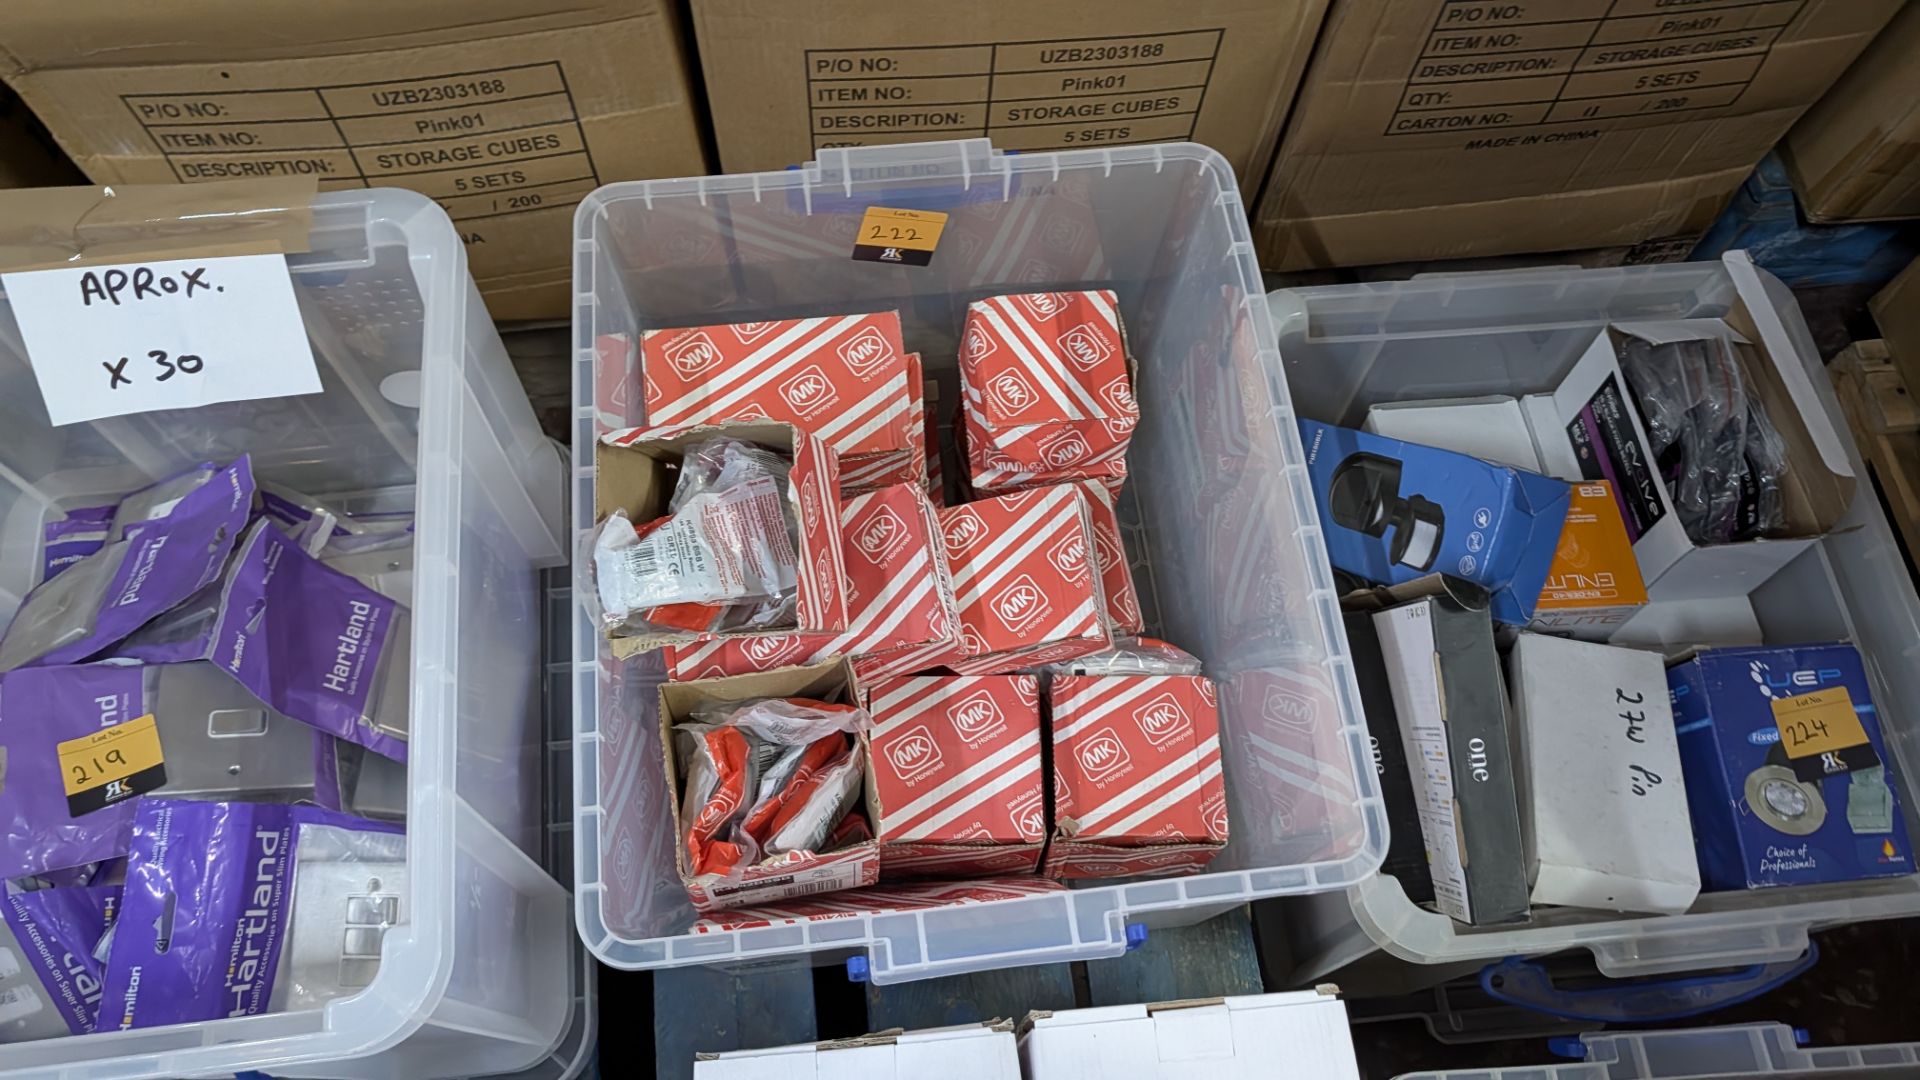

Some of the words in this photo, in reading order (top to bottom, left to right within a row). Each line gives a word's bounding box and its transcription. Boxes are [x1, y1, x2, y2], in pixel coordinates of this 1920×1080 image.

[1446, 8, 1483, 23] P/O
[1485, 5, 1526, 20] NO:
[1658, 16, 1724, 34] Pink01
[1040, 43, 1164, 64] UZB2303188
[1432, 36, 1481, 51] ITEM
[1484, 34, 1523, 48] NO:
[1594, 46, 1689, 65] STORAGE
[1689, 36, 1759, 53] CUBES
[816, 58, 853, 73] P/O
[860, 57, 898, 72] NO:
[1419, 58, 1557, 78] DESCRIPTION:
[1062, 74, 1126, 91] Pink01
[1635, 75, 1648, 89] 5
[1650, 70, 1701, 87] SETS
[372, 79, 506, 107] UZB2303188
[818, 88, 867, 102] ITEM
[874, 87, 912, 100] NO:
[1408, 91, 1453, 106] QTY:
[138, 103, 181, 119] P/O
[184, 102, 229, 117] NO:
[820, 112, 965, 129] DESCRIPTION:
[1008, 103, 1105, 121] STORAGE
[1111, 96, 1180, 114] CUBES
[415, 113, 485, 134] Pink01
[1397, 115, 1475, 131] CARTON
[1478, 112, 1514, 125] NO:
[160, 132, 217, 148] ITEM
[218, 131, 263, 146] NO:
[1063, 131, 1075, 143] 5
[1080, 127, 1131, 142] SETS
[1464, 136, 1521, 151] MADE
[1521, 134, 1542, 146] IN
[1543, 129, 1602, 144] CHINA
[376, 145, 484, 169] STORAGE
[487, 134, 561, 157] CUBES
[181, 159, 336, 179] DESCRIPTION:
[455, 178, 467, 191] 5
[472, 170, 526, 190] SETS
[508, 194, 542, 209] 200
[870, 225, 923, 241] 222
[678, 344, 711, 369] MK
[850, 338, 881, 363] MK
[1071, 336, 1096, 362] MK
[148, 350, 204, 382] 30
[791, 377, 822, 403] MK
[999, 378, 1026, 406] MK
[1052, 441, 1081, 464] MK
[864, 518, 893, 550] MK
[946, 517, 976, 546] MK
[1543, 572, 1616, 589] ENLIT
[1003, 588, 1035, 617] MK
[322, 600, 371, 692] Hartland
[960, 703, 991, 729] MK
[1145, 705, 1177, 731] MK
[1751, 731, 1778, 743] Fixed
[1786, 718, 1829, 747] 224
[897, 739, 929, 765] MK
[1085, 740, 1117, 767] MK
[1468, 737, 1490, 783] one
[72, 749, 127, 784] 219
[280, 826, 290, 855] Plates
[1766, 846, 1795, 858] Choice
[1798, 843, 1808, 858] of
[277, 857, 286, 877] Slim
[1760, 857, 1816, 874] Professionals
[273, 880, 282, 908] Super
[228, 830, 280, 1018] Hartland
[271, 908, 278, 921] on
[10, 895, 30, 922] uality
[25, 922, 56, 970] Accessories
[52, 968, 64, 983] on
[59, 980, 78, 1006] Super
[73, 1003, 88, 1024] Slim
[224, 918, 245, 988] Hamilton
[258, 924, 277, 977] Accessories
[247, 979, 264, 1015] Quality
